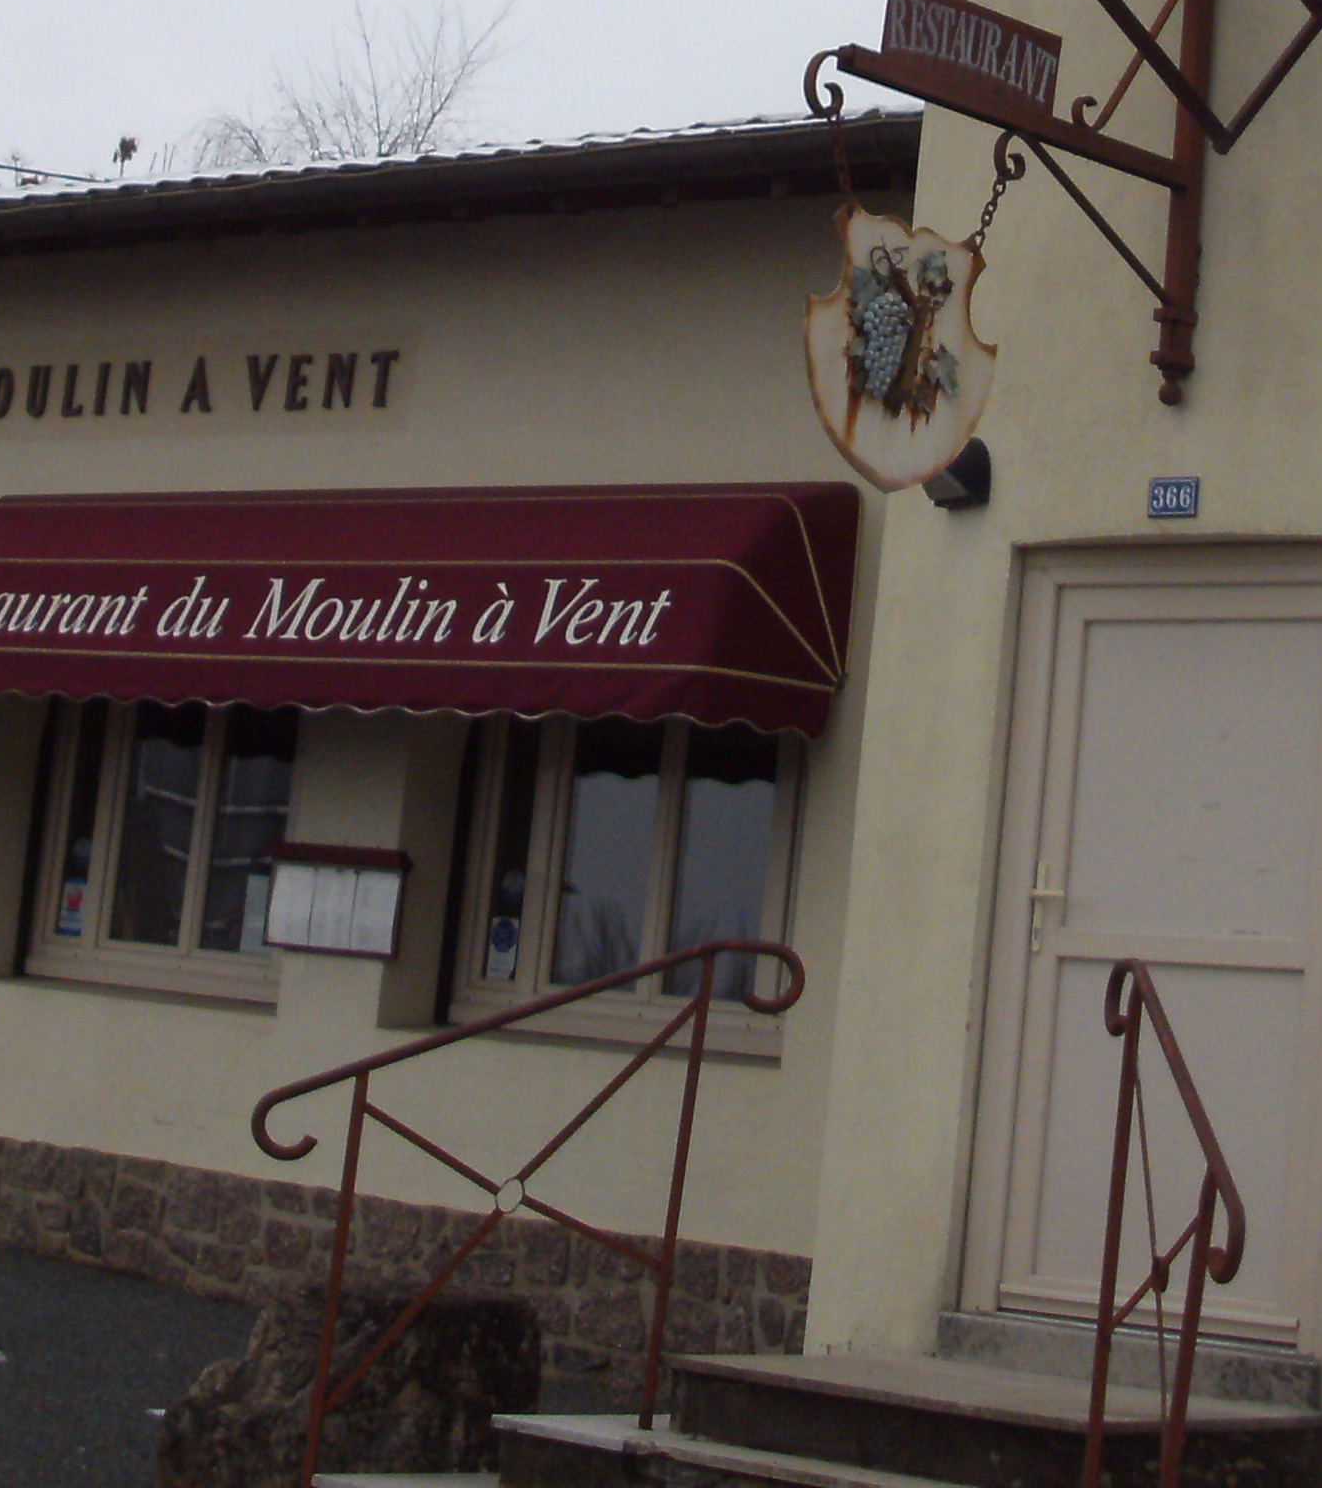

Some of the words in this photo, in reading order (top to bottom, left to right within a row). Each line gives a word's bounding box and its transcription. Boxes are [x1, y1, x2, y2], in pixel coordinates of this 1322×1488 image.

[179, 355, 213, 413] A
[245, 348, 400, 411] VENT
[1152, 485, 1191, 509] 366
[156, 575, 231, 639] du
[242, 575, 458, 644] Moulin
[471, 581, 516, 645] à
[533, 578, 672, 646] Vent
